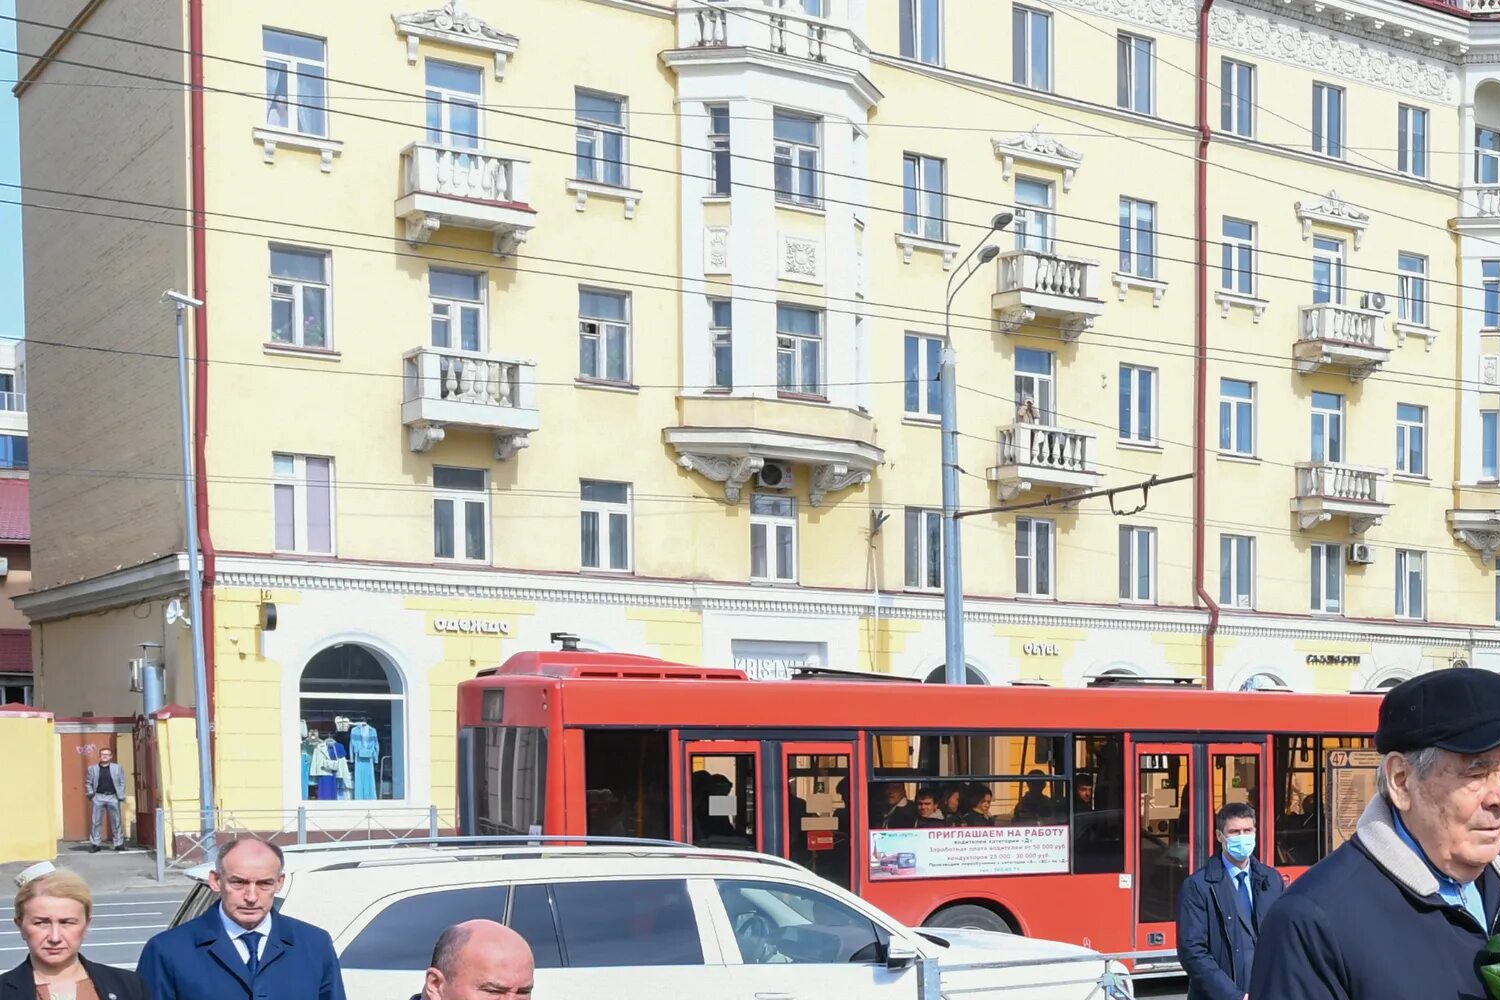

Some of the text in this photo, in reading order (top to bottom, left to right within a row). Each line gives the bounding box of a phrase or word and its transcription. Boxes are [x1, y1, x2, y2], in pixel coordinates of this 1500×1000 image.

[1332, 752, 1345, 766] 47
[928, 830, 1003, 839] ПРИГЛАШАЕМ
[1007, 829, 1021, 837] НА
[1024, 828, 1064, 837] РАБОТУ
